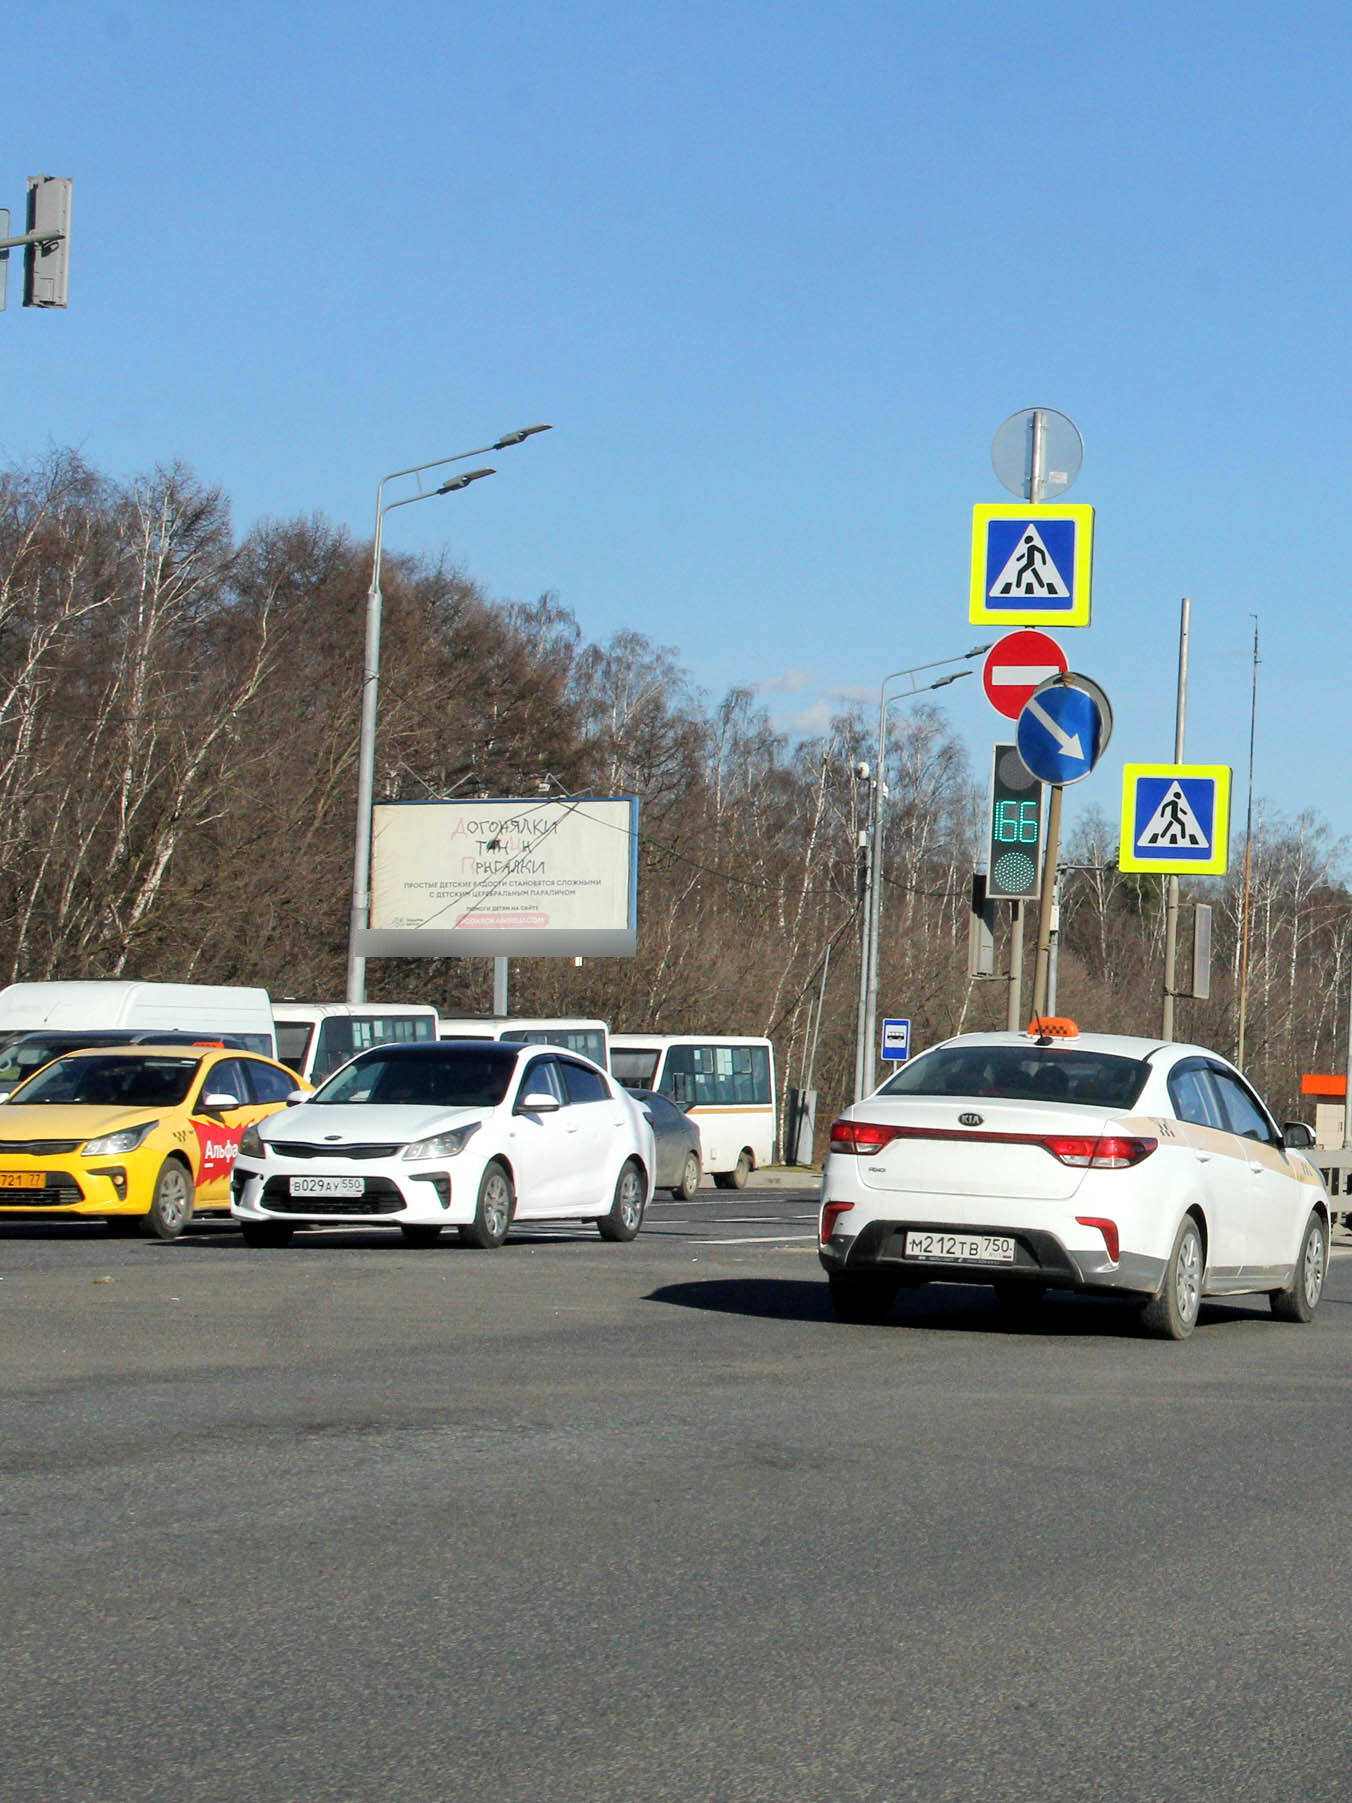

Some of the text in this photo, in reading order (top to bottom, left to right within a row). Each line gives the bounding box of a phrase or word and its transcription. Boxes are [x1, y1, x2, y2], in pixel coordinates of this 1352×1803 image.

[451, 817, 557, 840] ДОГОНЯЛКИ
[439, 881, 472, 889] ДЕТСКИЕ
[473, 880, 508, 888] РАДОСТИ
[472, 890, 529, 898] ЦЕРЕБРАЛЬНЫМ
[530, 889, 576, 897] ПАРАЛИЧОМ
[961, 1115, 980, 1124] KIA
[205, 1139, 239, 1163] Альфа
[983, 1238, 1010, 1253] 750
